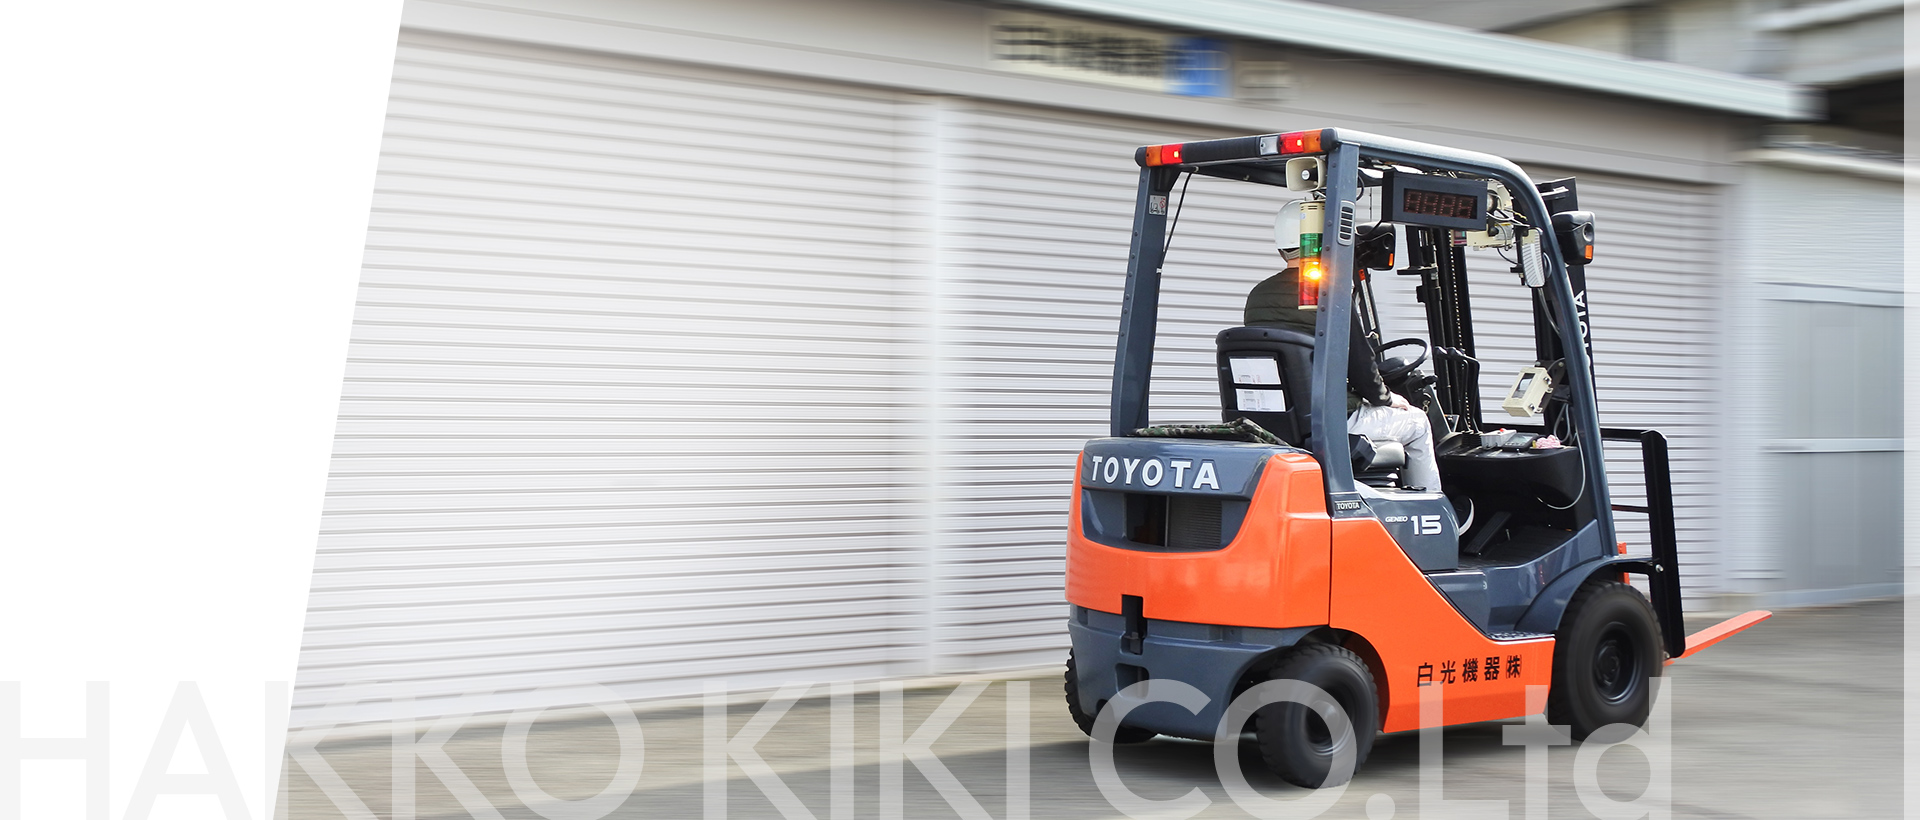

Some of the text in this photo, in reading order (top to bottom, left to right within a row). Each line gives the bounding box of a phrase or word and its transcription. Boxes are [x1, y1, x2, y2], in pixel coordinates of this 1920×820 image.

[1091, 455, 1221, 490] TOYOTA
[1336, 502, 1361, 511] TOYOTA
[1385, 514, 1443, 536] GENEO 15
